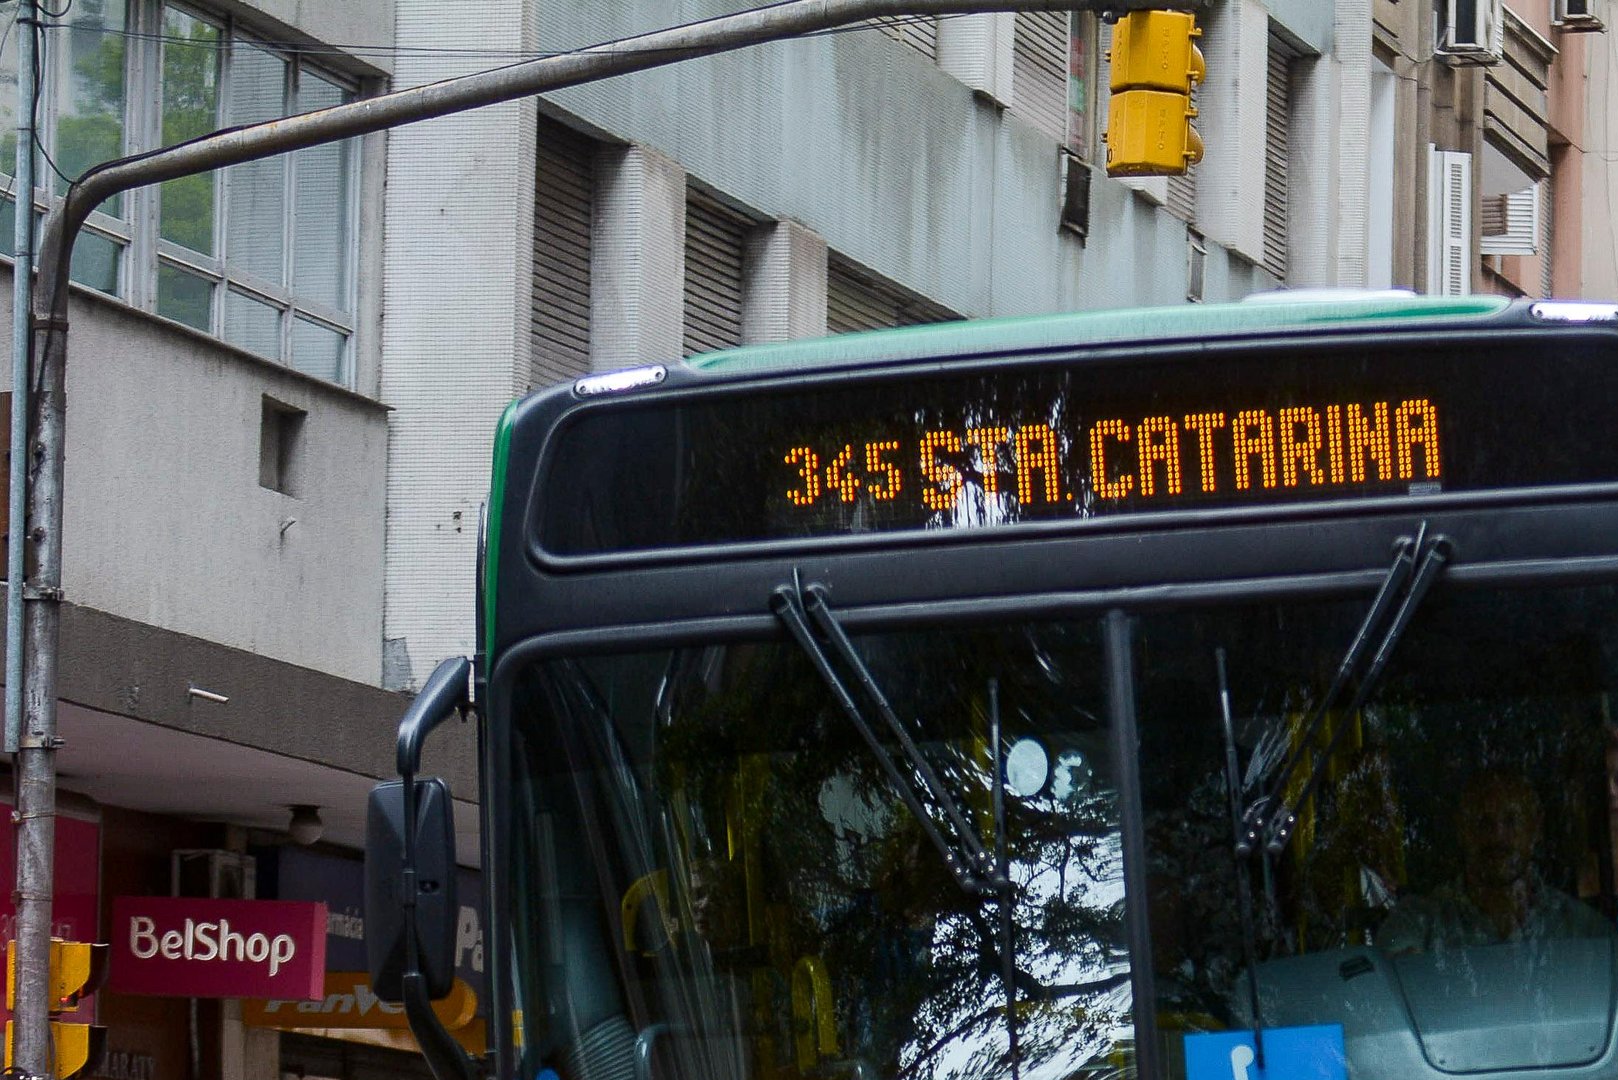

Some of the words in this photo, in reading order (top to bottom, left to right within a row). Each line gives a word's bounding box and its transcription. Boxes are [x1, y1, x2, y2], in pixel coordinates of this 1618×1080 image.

[784, 440, 901, 505] 345
[919, 424, 1073, 510] STA.
[1089, 399, 1441, 498] CATARINA
[129, 916, 296, 977] BelShop
